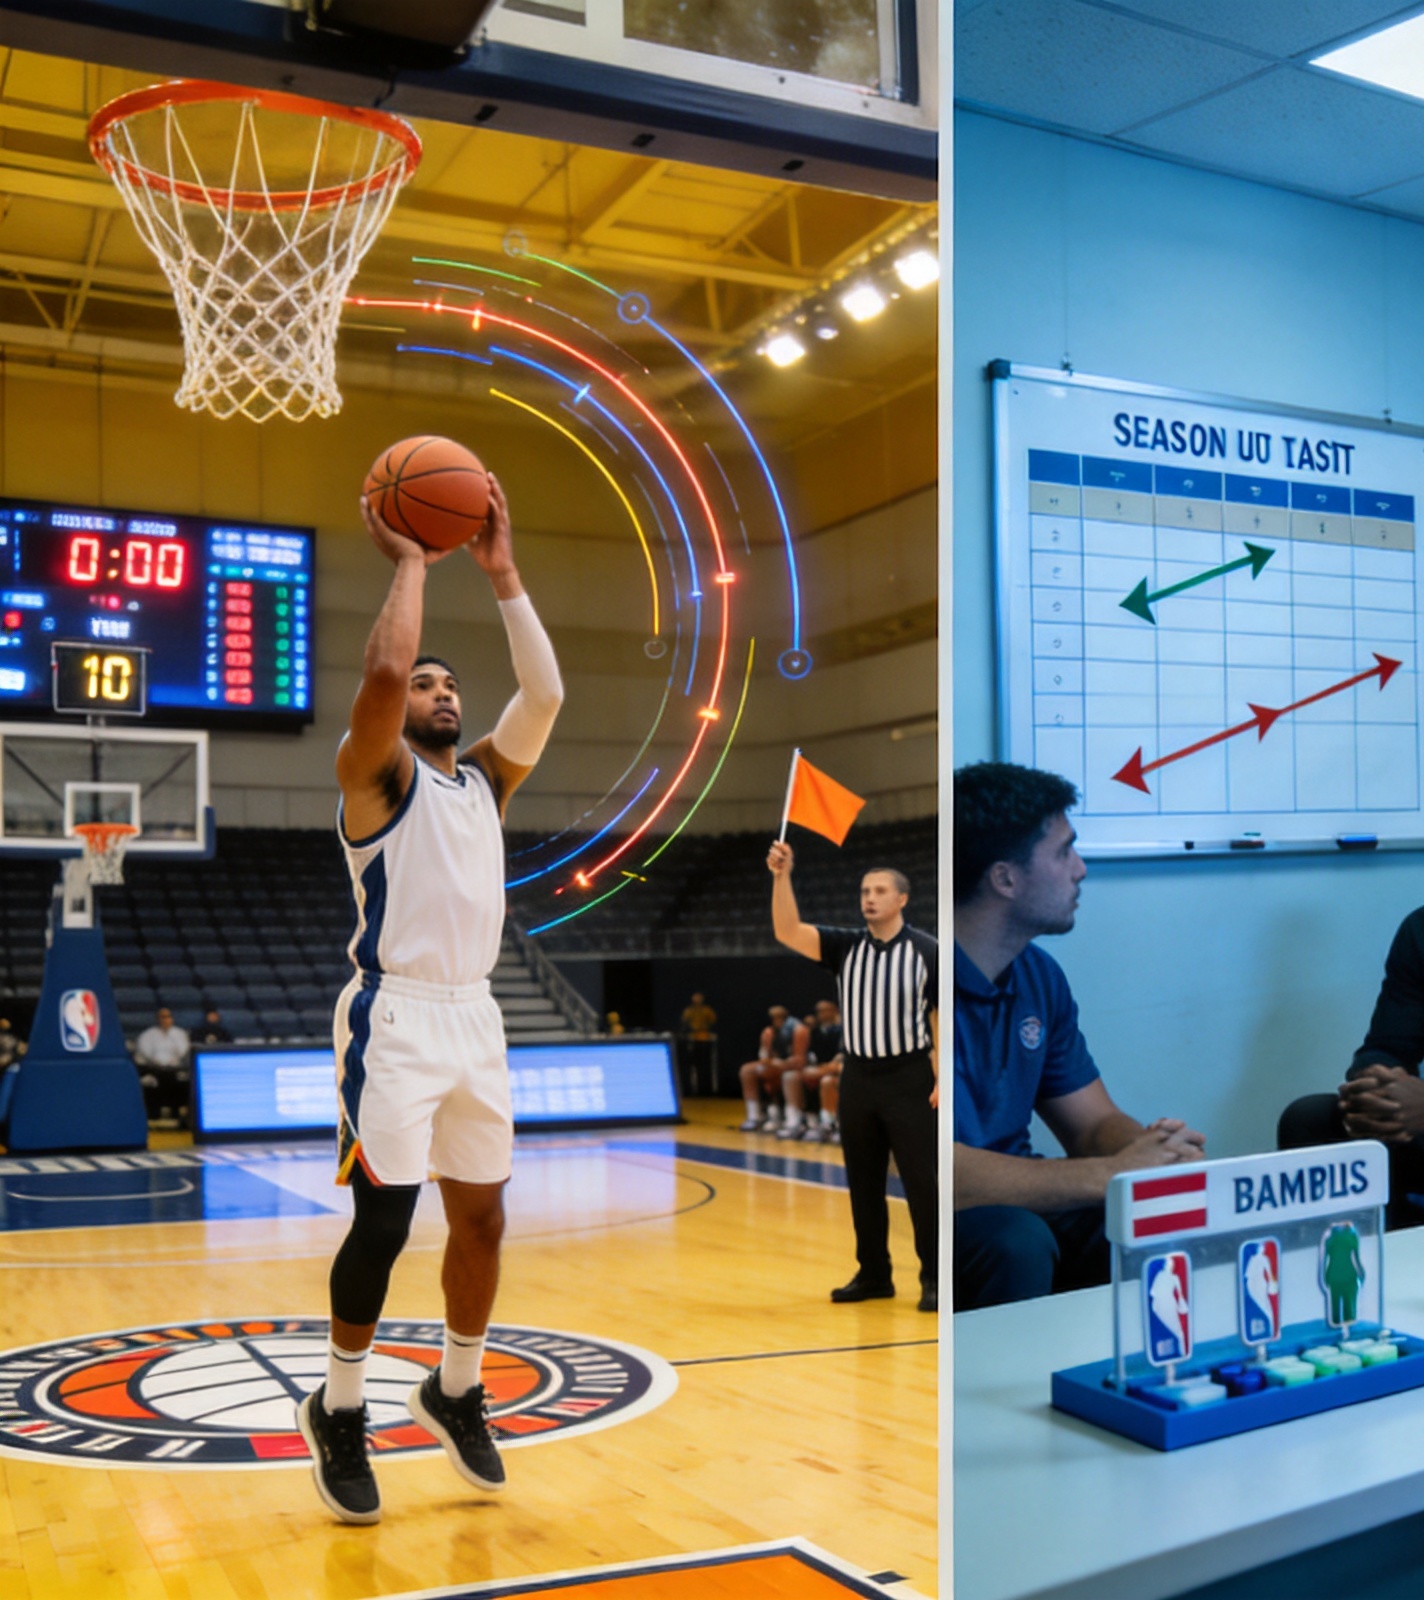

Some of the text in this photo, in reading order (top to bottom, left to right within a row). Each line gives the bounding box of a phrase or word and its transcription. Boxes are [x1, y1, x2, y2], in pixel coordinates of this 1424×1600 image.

[1113, 412, 1227, 460] SEASON
[69, 537, 185, 588] 0:00
[83, 654, 132, 701] 10
